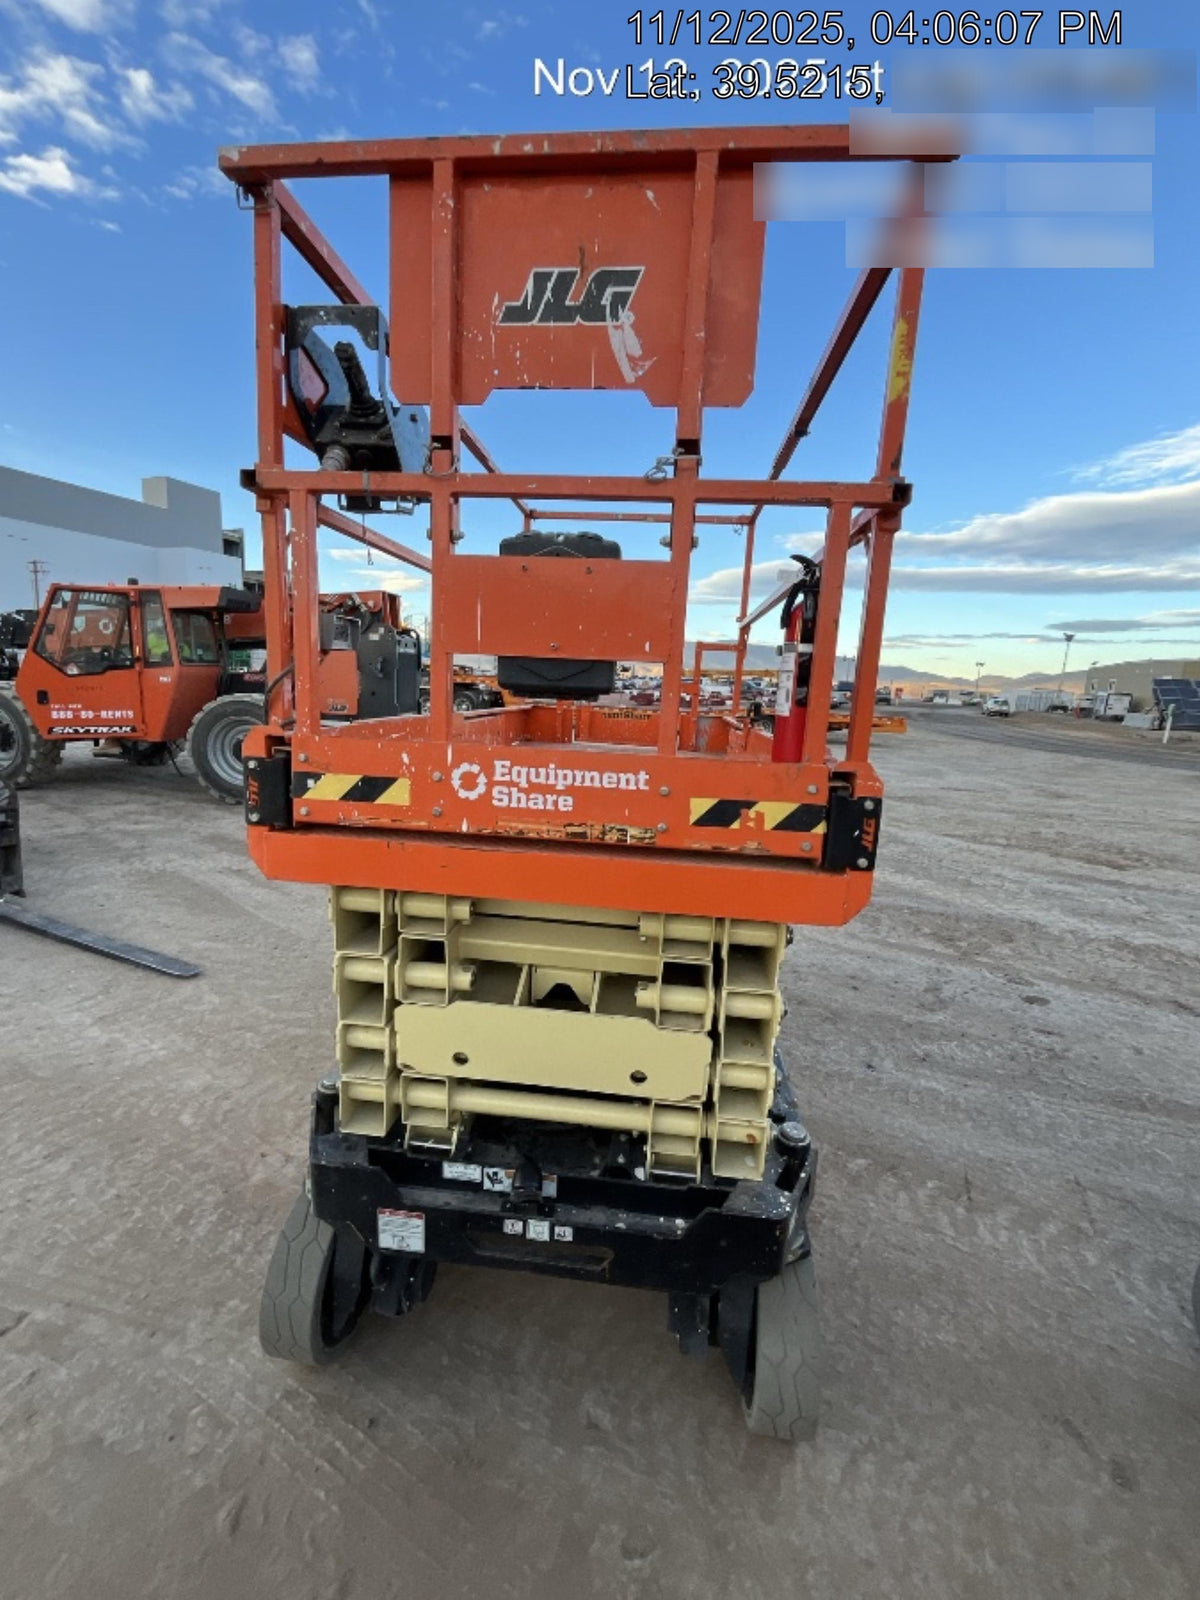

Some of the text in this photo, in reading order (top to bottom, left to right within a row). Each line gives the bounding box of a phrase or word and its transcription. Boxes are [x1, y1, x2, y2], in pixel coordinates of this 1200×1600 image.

[497, 266, 645, 326] JLG
[52, 726, 132, 734] SKYTRAK
[493, 760, 650, 790] Equipment
[492, 785, 574, 812] Share
